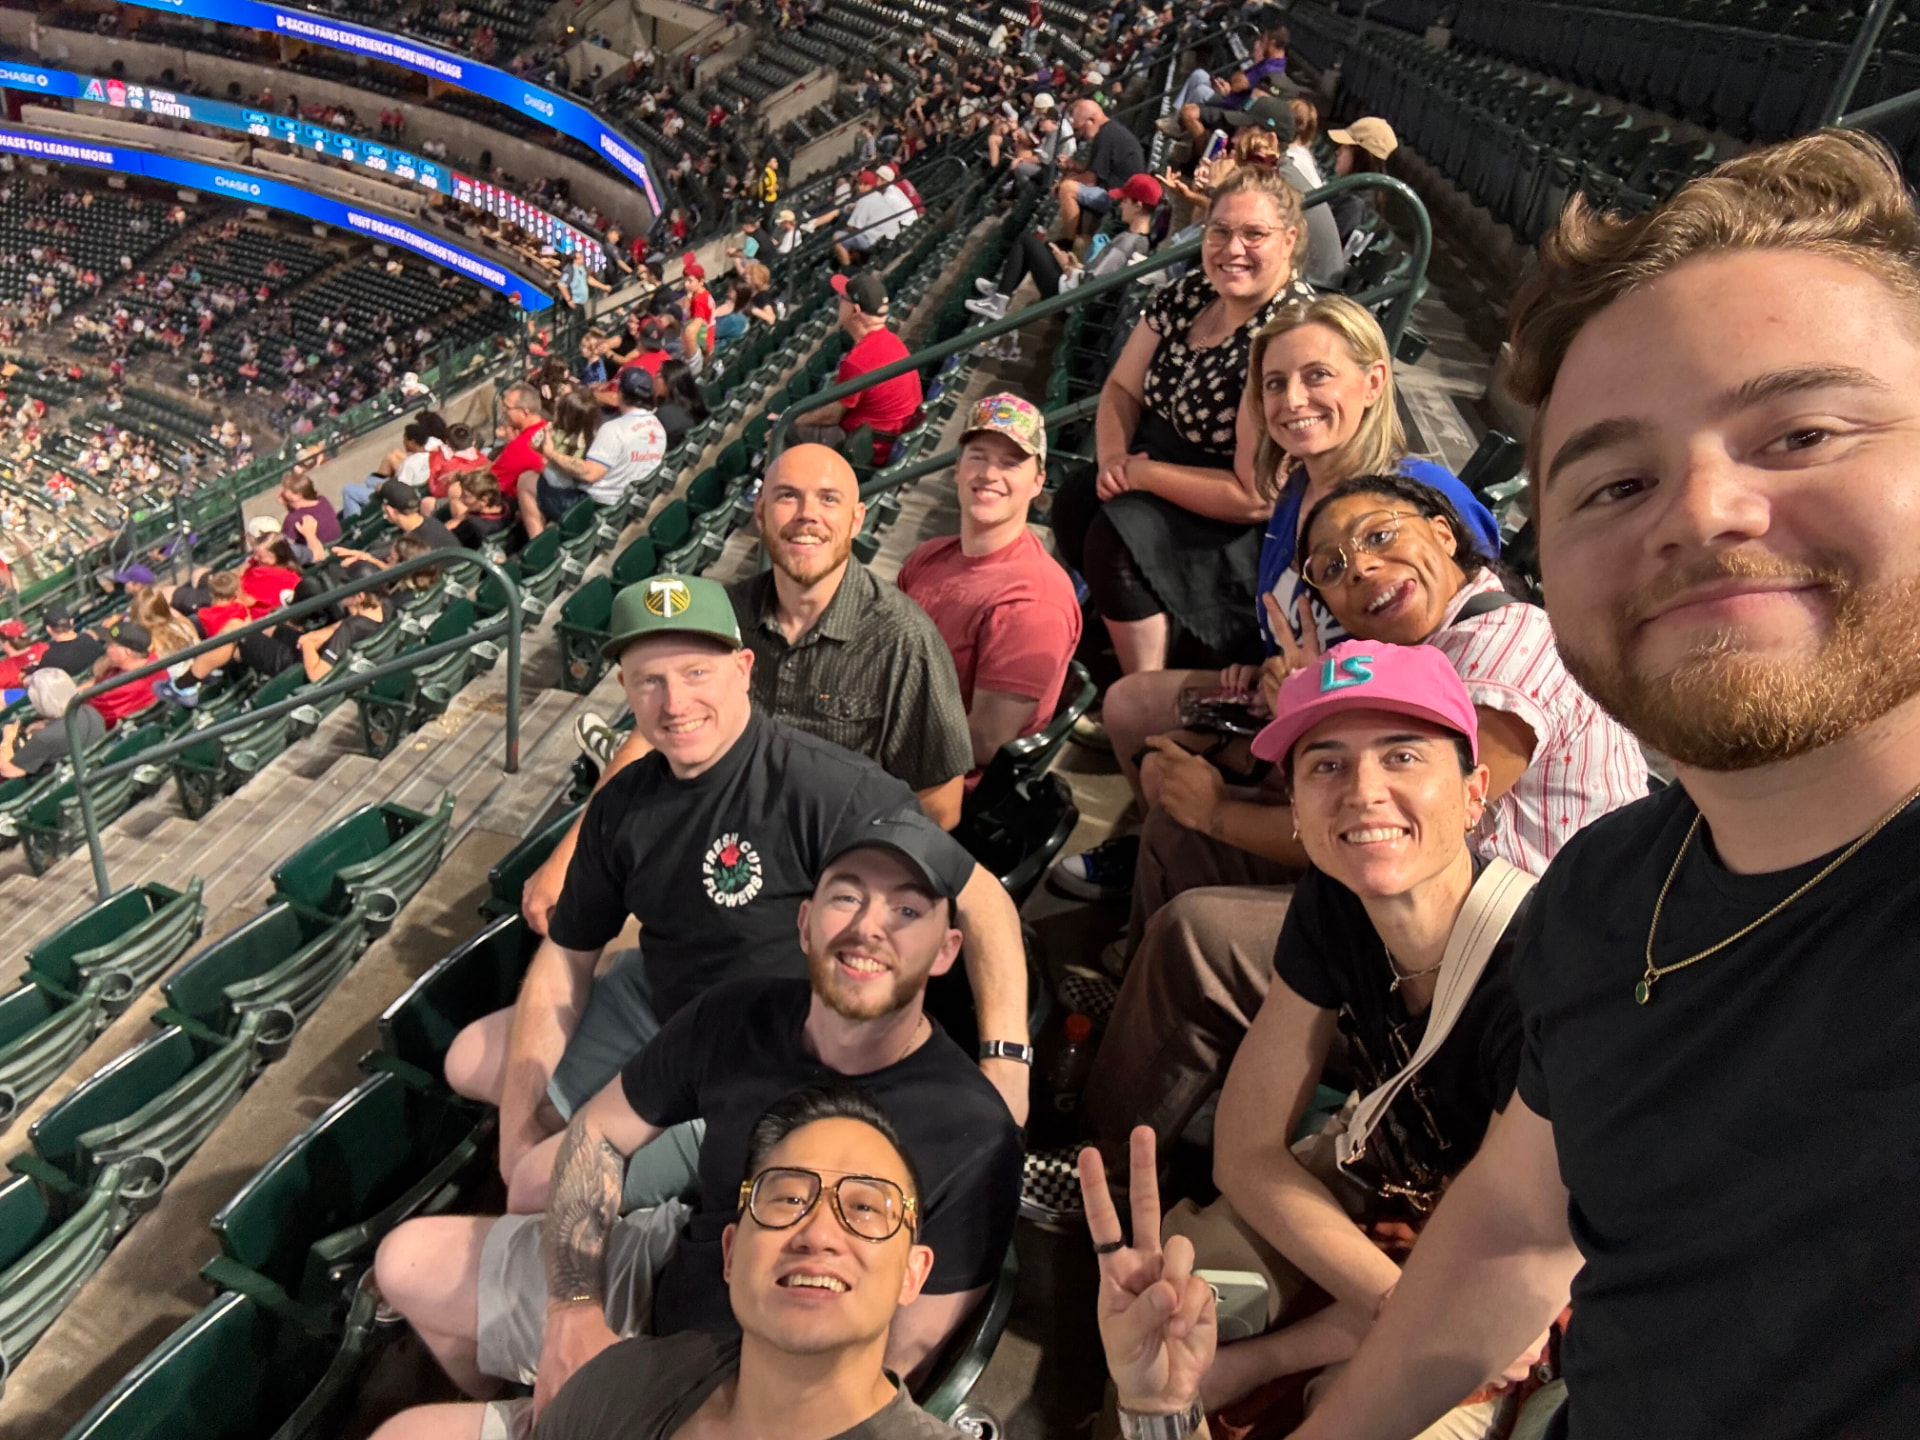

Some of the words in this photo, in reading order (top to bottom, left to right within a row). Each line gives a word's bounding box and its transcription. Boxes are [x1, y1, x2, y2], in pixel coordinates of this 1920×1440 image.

[276, 15, 314, 35] D-BACKS
[151, 100, 191, 119] SMITH
[0, 134, 26, 149] HASE
[26, 139, 42, 152] TO
[43, 142, 79, 158] LEARN
[80, 148, 114, 164] MORE
[214, 175, 249, 193] CHASE
[347, 212, 371, 230] VISIT
[1320, 655, 1374, 693] LS
[702, 832, 739, 875] FRESH
[739, 840, 762, 876] CUT
[702, 874, 763, 908] FLOWERS
